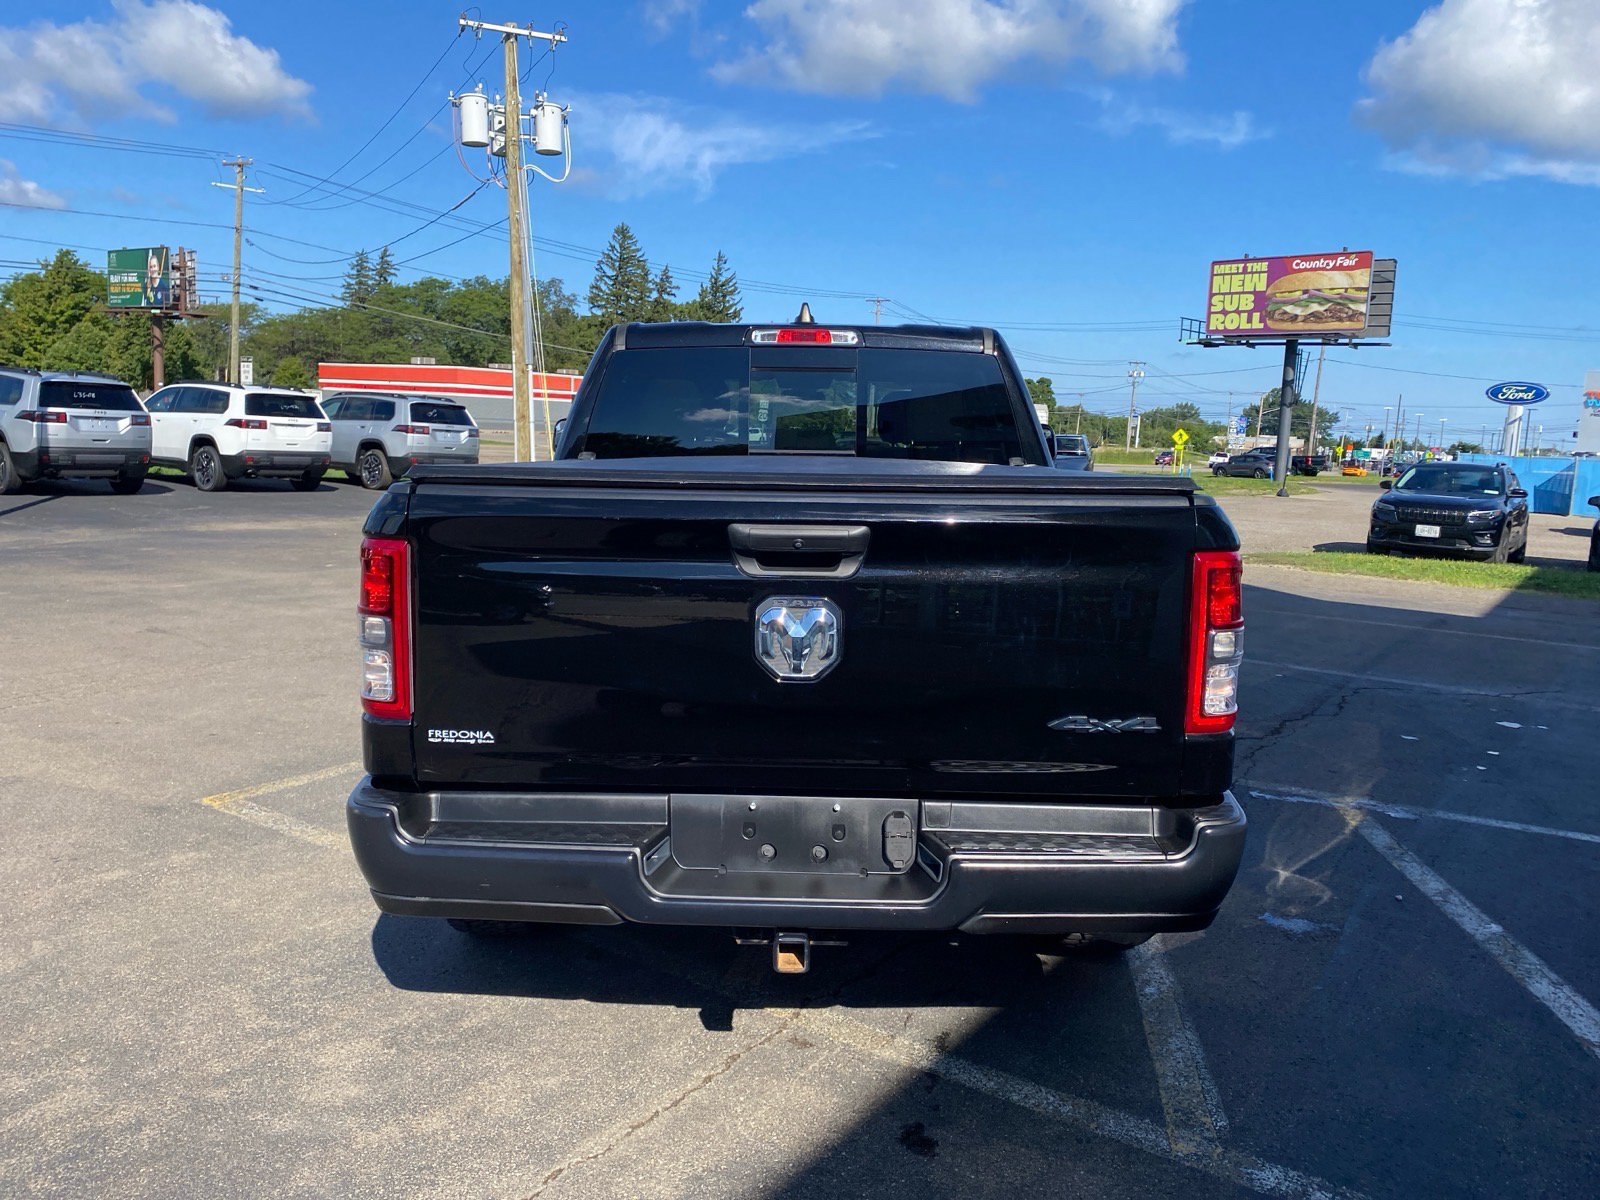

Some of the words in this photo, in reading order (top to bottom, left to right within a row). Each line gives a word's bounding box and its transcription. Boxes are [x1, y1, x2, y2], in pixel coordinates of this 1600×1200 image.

[1213, 264, 1244, 275] MEET
[1246, 262, 1268, 272] THE
[1292, 257, 1334, 270] Country
[1336, 254, 1359, 267] Fair
[1212, 273, 1268, 294] NEW
[1210, 293, 1254, 312] SUB
[1209, 312, 1264, 330] ROLL
[1498, 385, 1537, 400] Ford
[773, 599, 824, 608] RAM
[428, 729, 494, 739] FREDONIA
